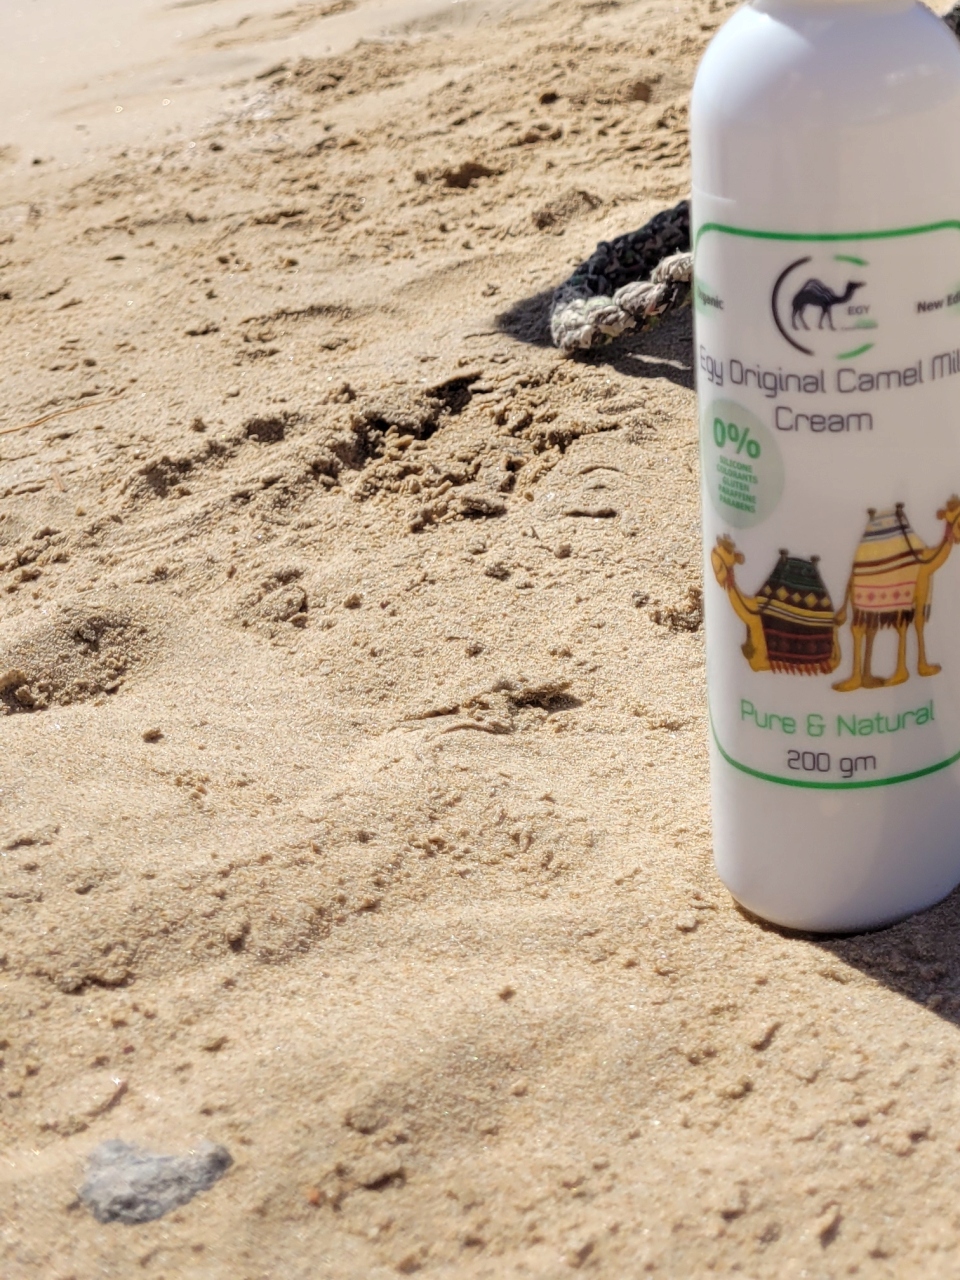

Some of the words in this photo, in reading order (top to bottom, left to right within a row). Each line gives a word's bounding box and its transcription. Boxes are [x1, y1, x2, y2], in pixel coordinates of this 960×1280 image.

[917, 299, 944, 314] New
[700, 344, 724, 387] Egy
[730, 359, 826, 398] Original
[837, 359, 924, 394] Camel
[775, 406, 873, 433] Cream
[713, 417, 761, 459] 0%
[741, 699, 796, 735] Pure
[806, 714, 826, 737] &
[838, 699, 935, 737] Natural
[787, 749, 830, 772] 200
[839, 754, 877, 779] gm
